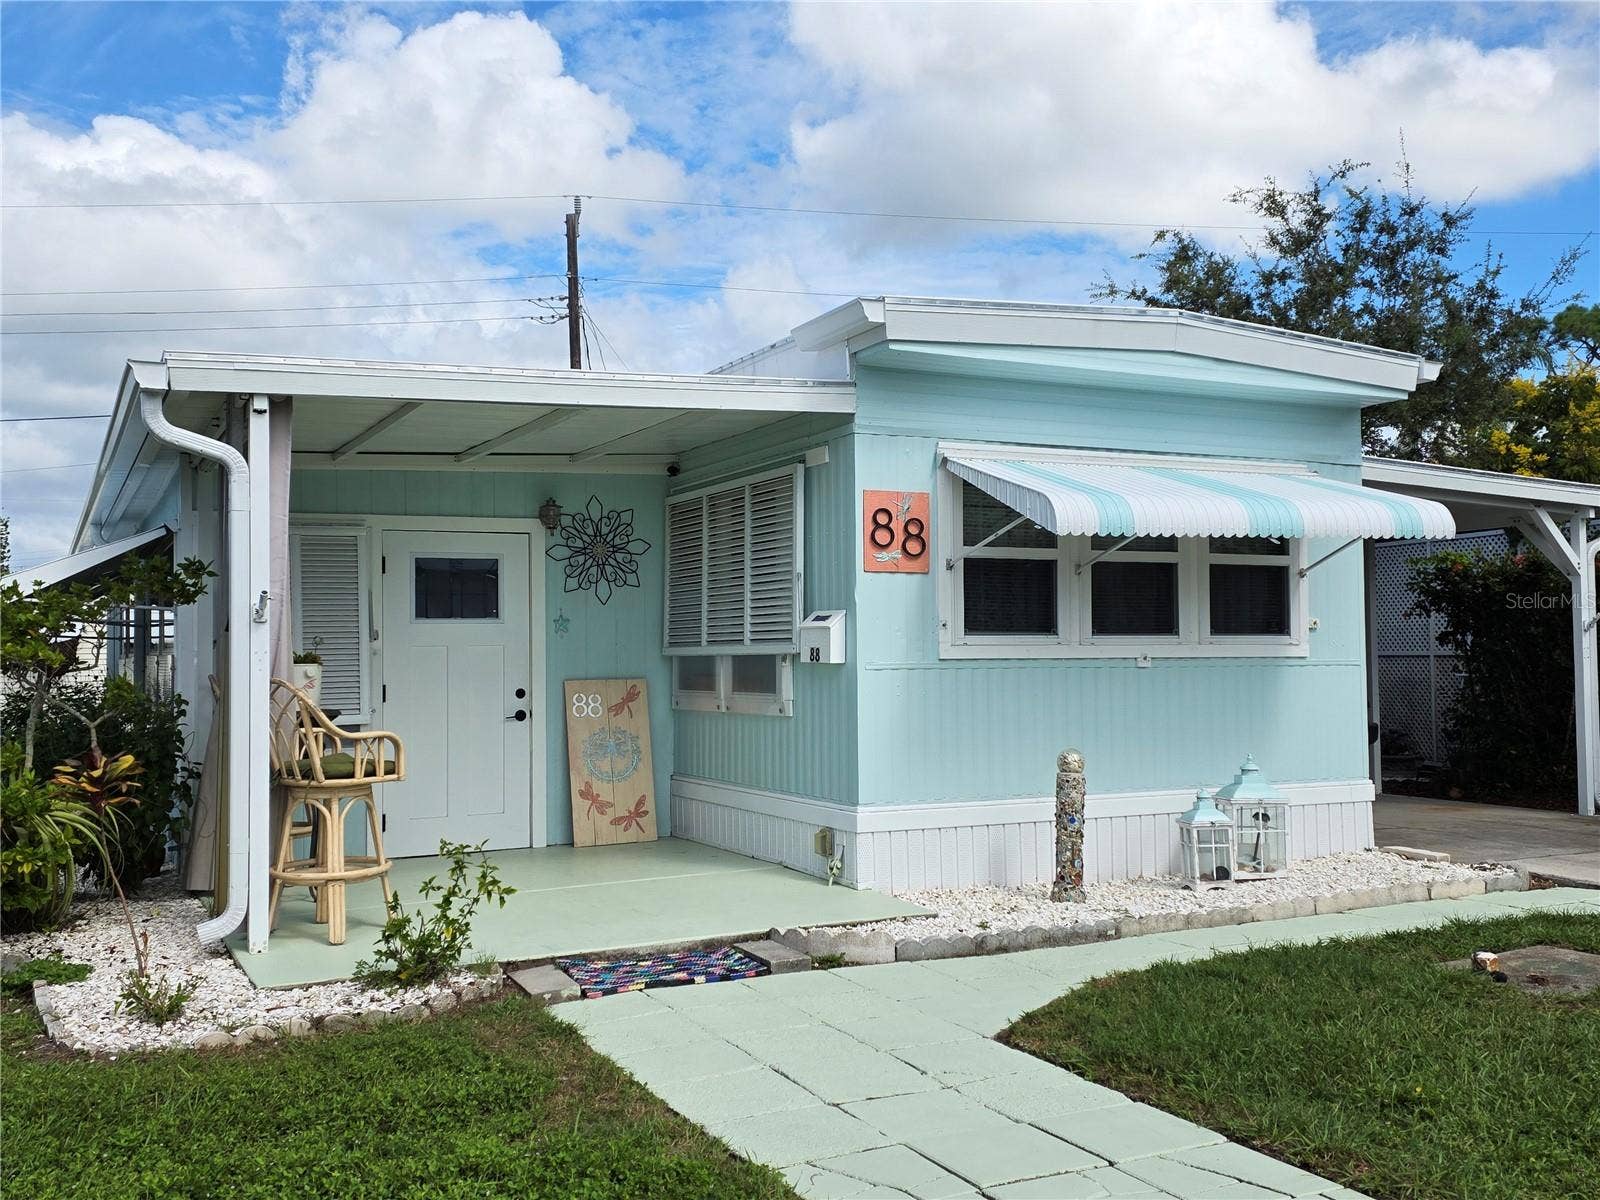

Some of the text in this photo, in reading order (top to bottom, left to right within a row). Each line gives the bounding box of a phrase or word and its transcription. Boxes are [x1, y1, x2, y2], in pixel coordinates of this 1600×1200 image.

[871, 508, 926, 557] 88
[809, 647, 820, 662] 88
[572, 693, 603, 718] 88
